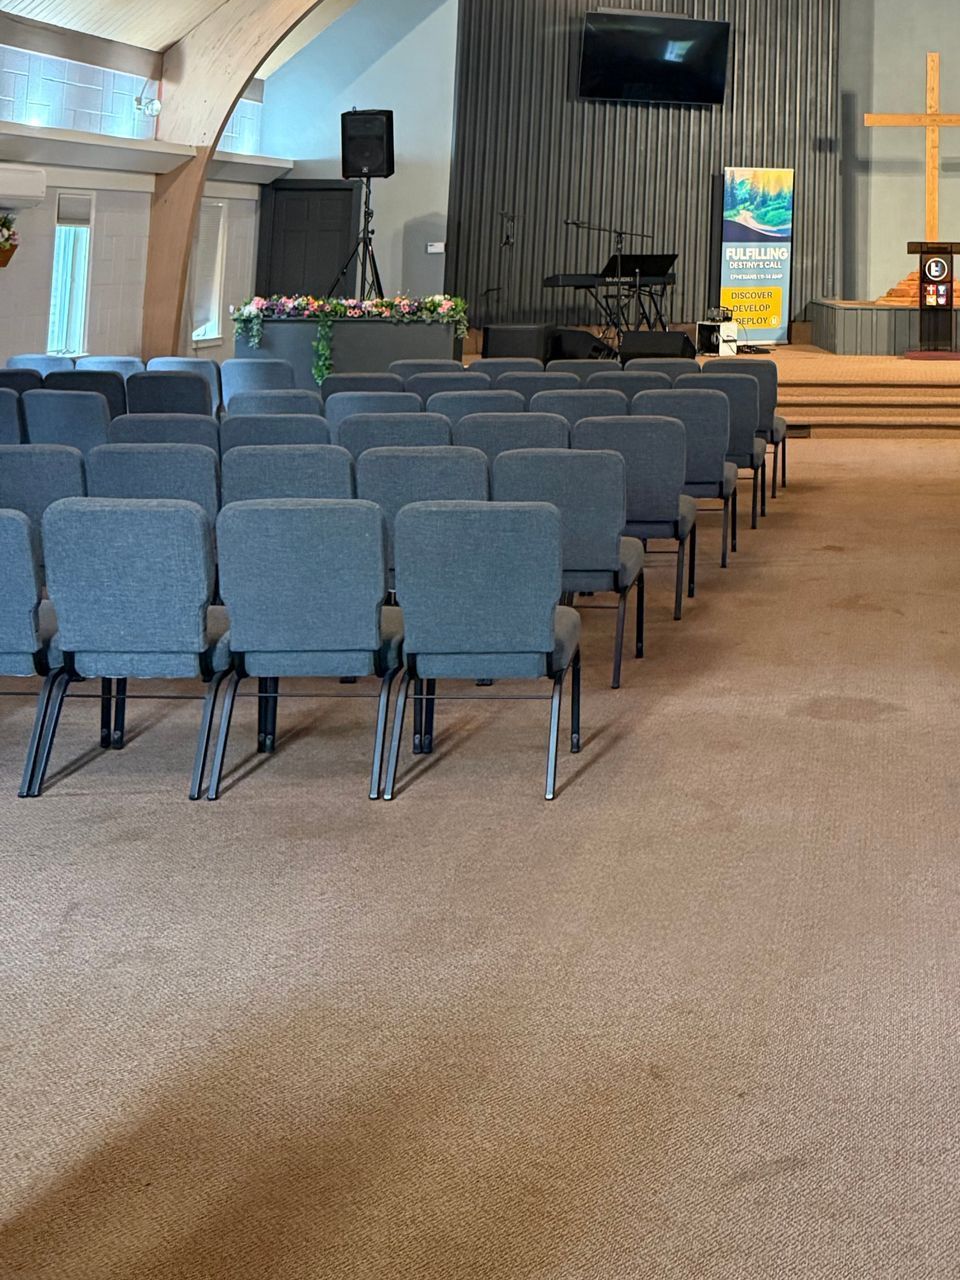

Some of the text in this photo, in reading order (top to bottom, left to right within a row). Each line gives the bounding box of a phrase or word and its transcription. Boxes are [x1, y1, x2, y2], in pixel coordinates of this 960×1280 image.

[726, 247, 788, 260] FULFILLING
[729, 261, 782, 269] DESTINY'S CALL
[731, 292, 773, 300] DISCOVER
[733, 304, 770, 313] DEVELOP
